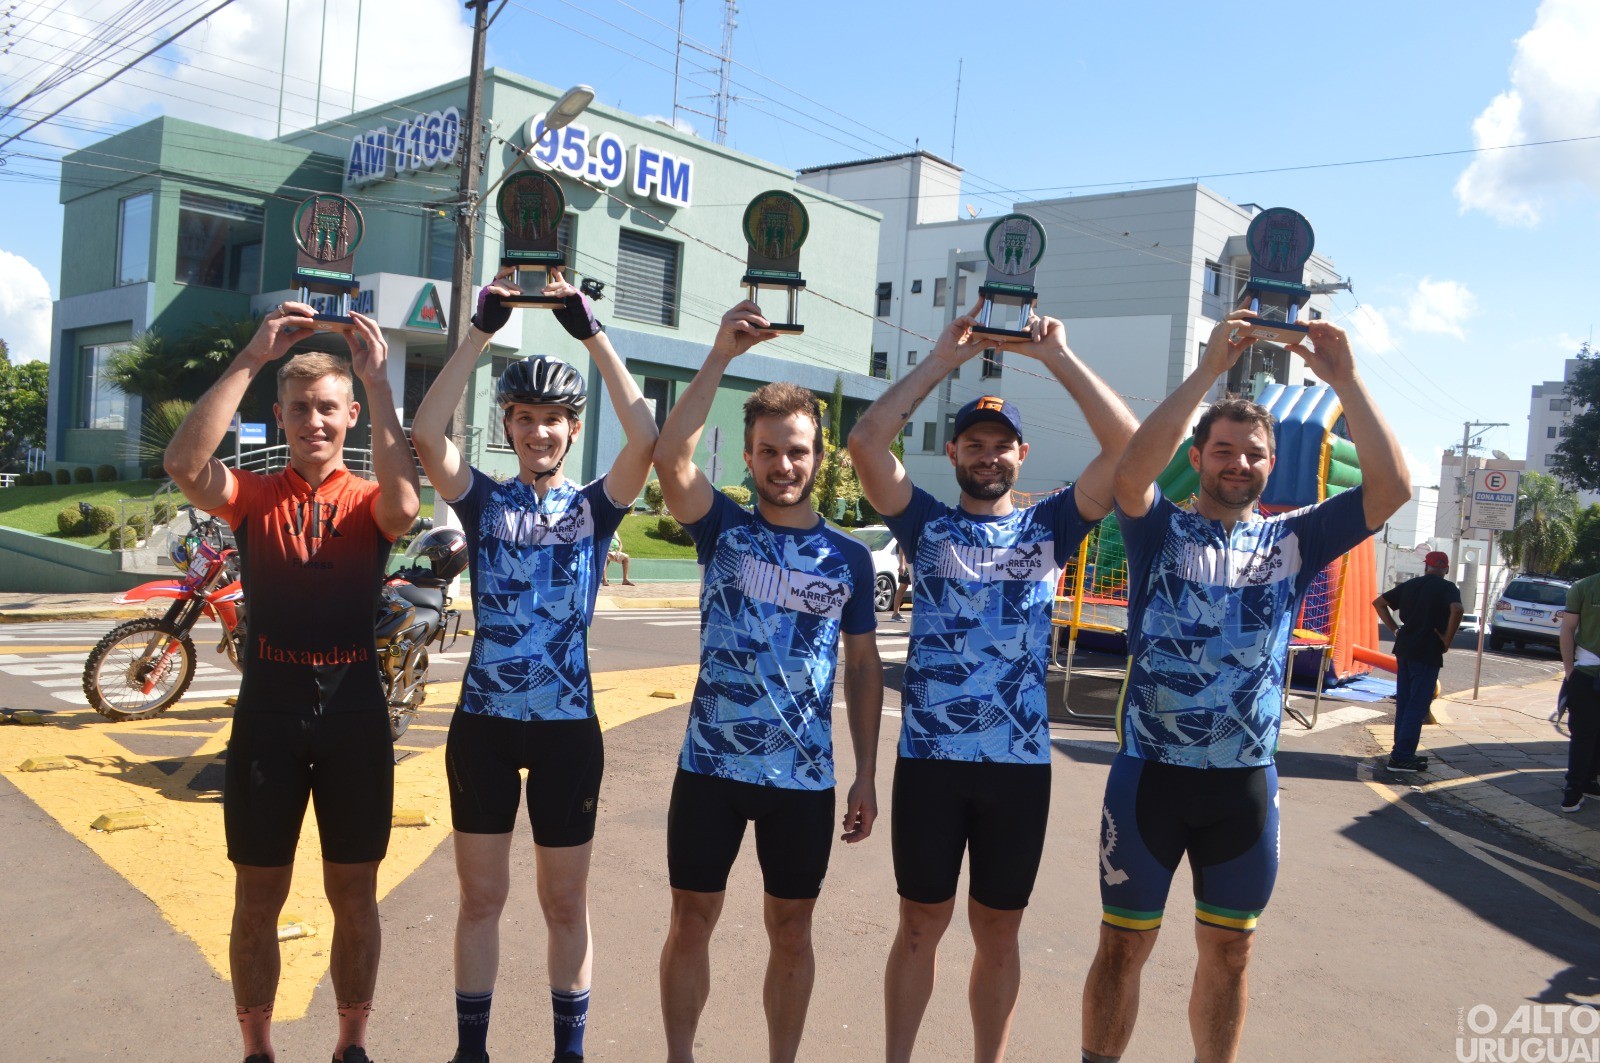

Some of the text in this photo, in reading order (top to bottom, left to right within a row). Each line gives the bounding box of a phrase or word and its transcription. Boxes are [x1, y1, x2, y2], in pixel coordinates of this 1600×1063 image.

[346, 111, 459, 182] AM 1160
[533, 117, 691, 204] 95.9 FM
[1006, 239, 1025, 247] 2023
[1491, 475, 1501, 487] E
[1476, 493, 1513, 502] ZONA AZUL
[284, 502, 344, 538] JR
[995, 558, 1042, 572] MRRETA'S
[790, 586, 843, 608] MARRETA'S
[258, 637, 368, 666] Itaxandaia
